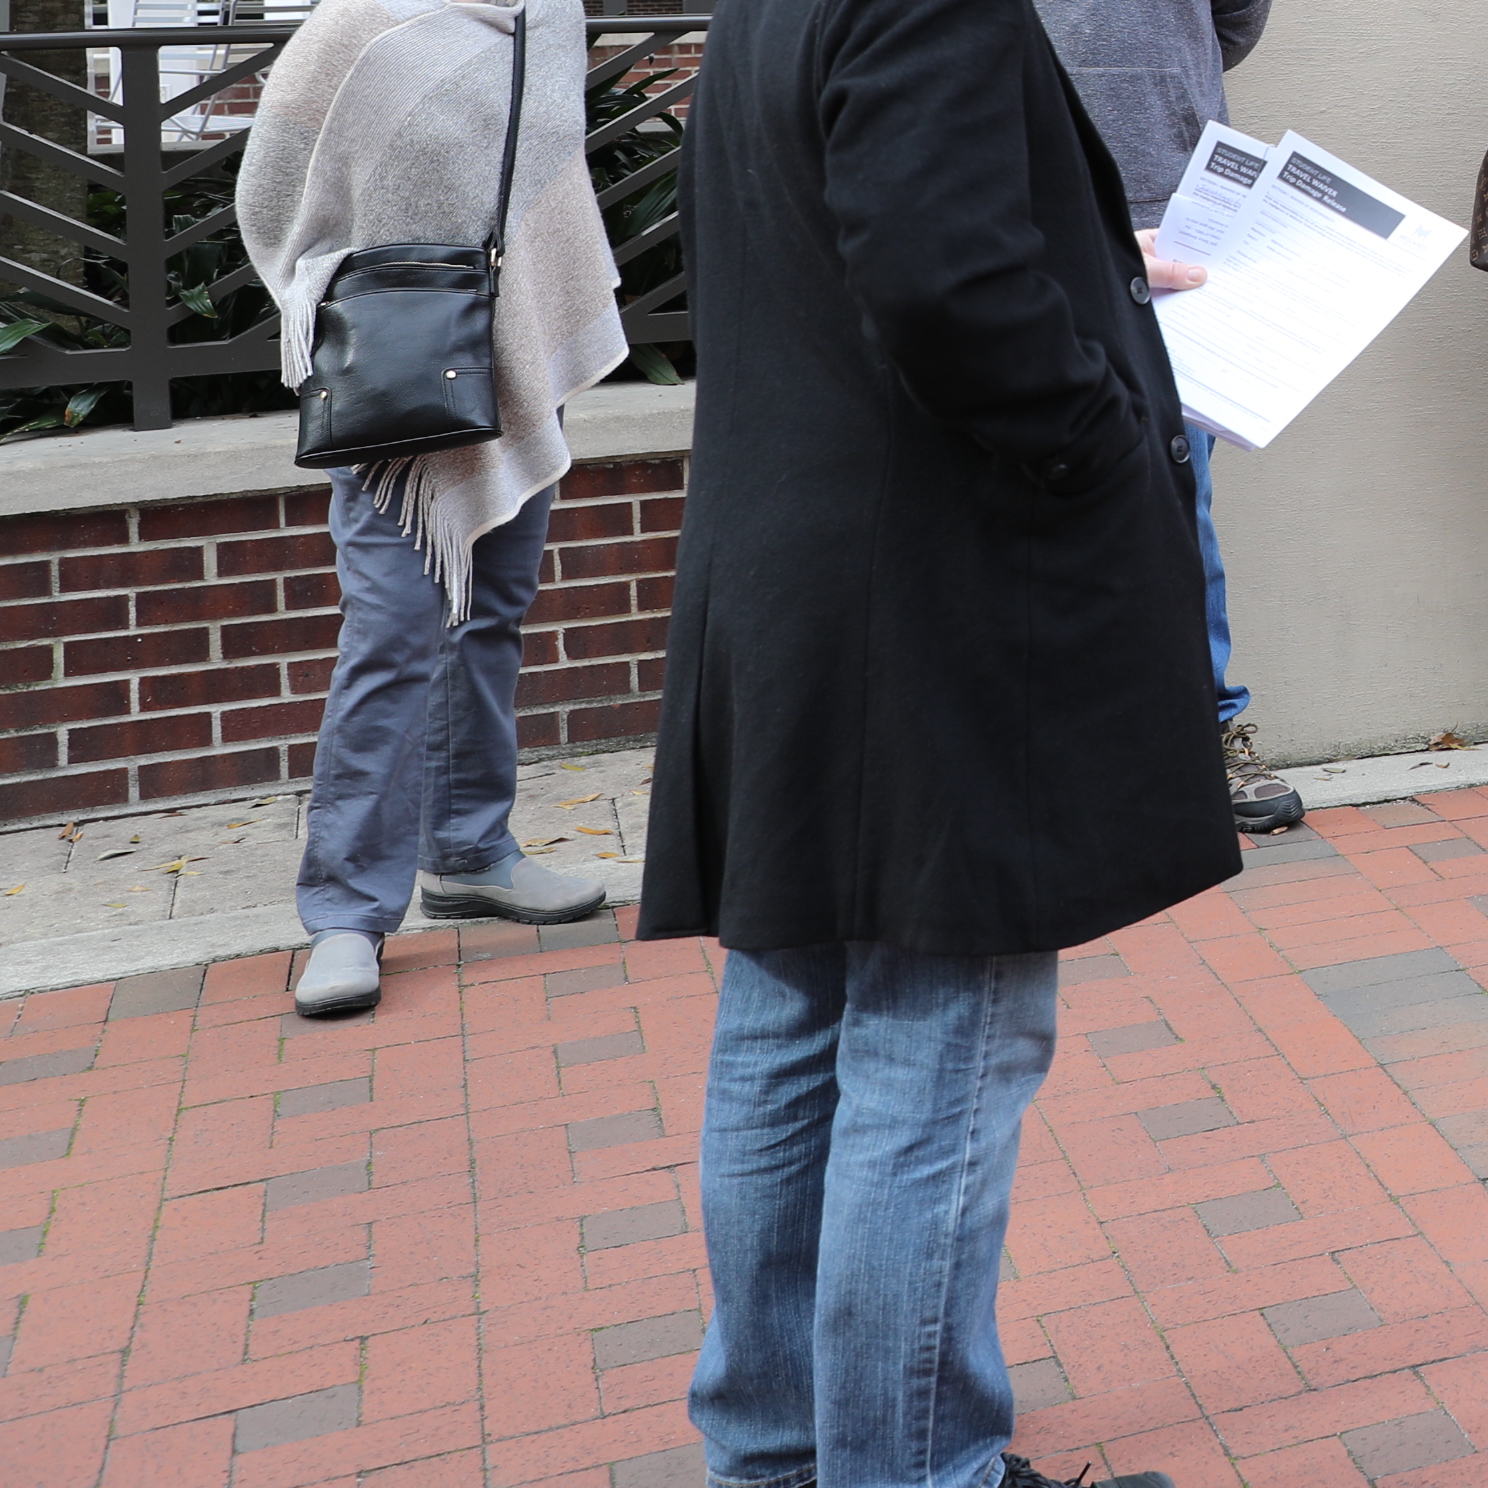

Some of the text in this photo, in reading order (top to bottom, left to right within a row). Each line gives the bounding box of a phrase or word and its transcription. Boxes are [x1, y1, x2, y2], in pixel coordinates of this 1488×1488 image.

[1213, 154, 1239, 170] TRAVEL
[1216, 147, 1260, 169] STUDENT LIFE
[1291, 157, 1332, 184] STUDENT LIFE
[1210, 161, 1253, 185] Trip Damage
[1287, 163, 1338, 198] TRAVEL WAIVER
[1282, 171, 1296, 183] Trip
[1295, 179, 1323, 198] Damage
[1322, 195, 1347, 213] Release
